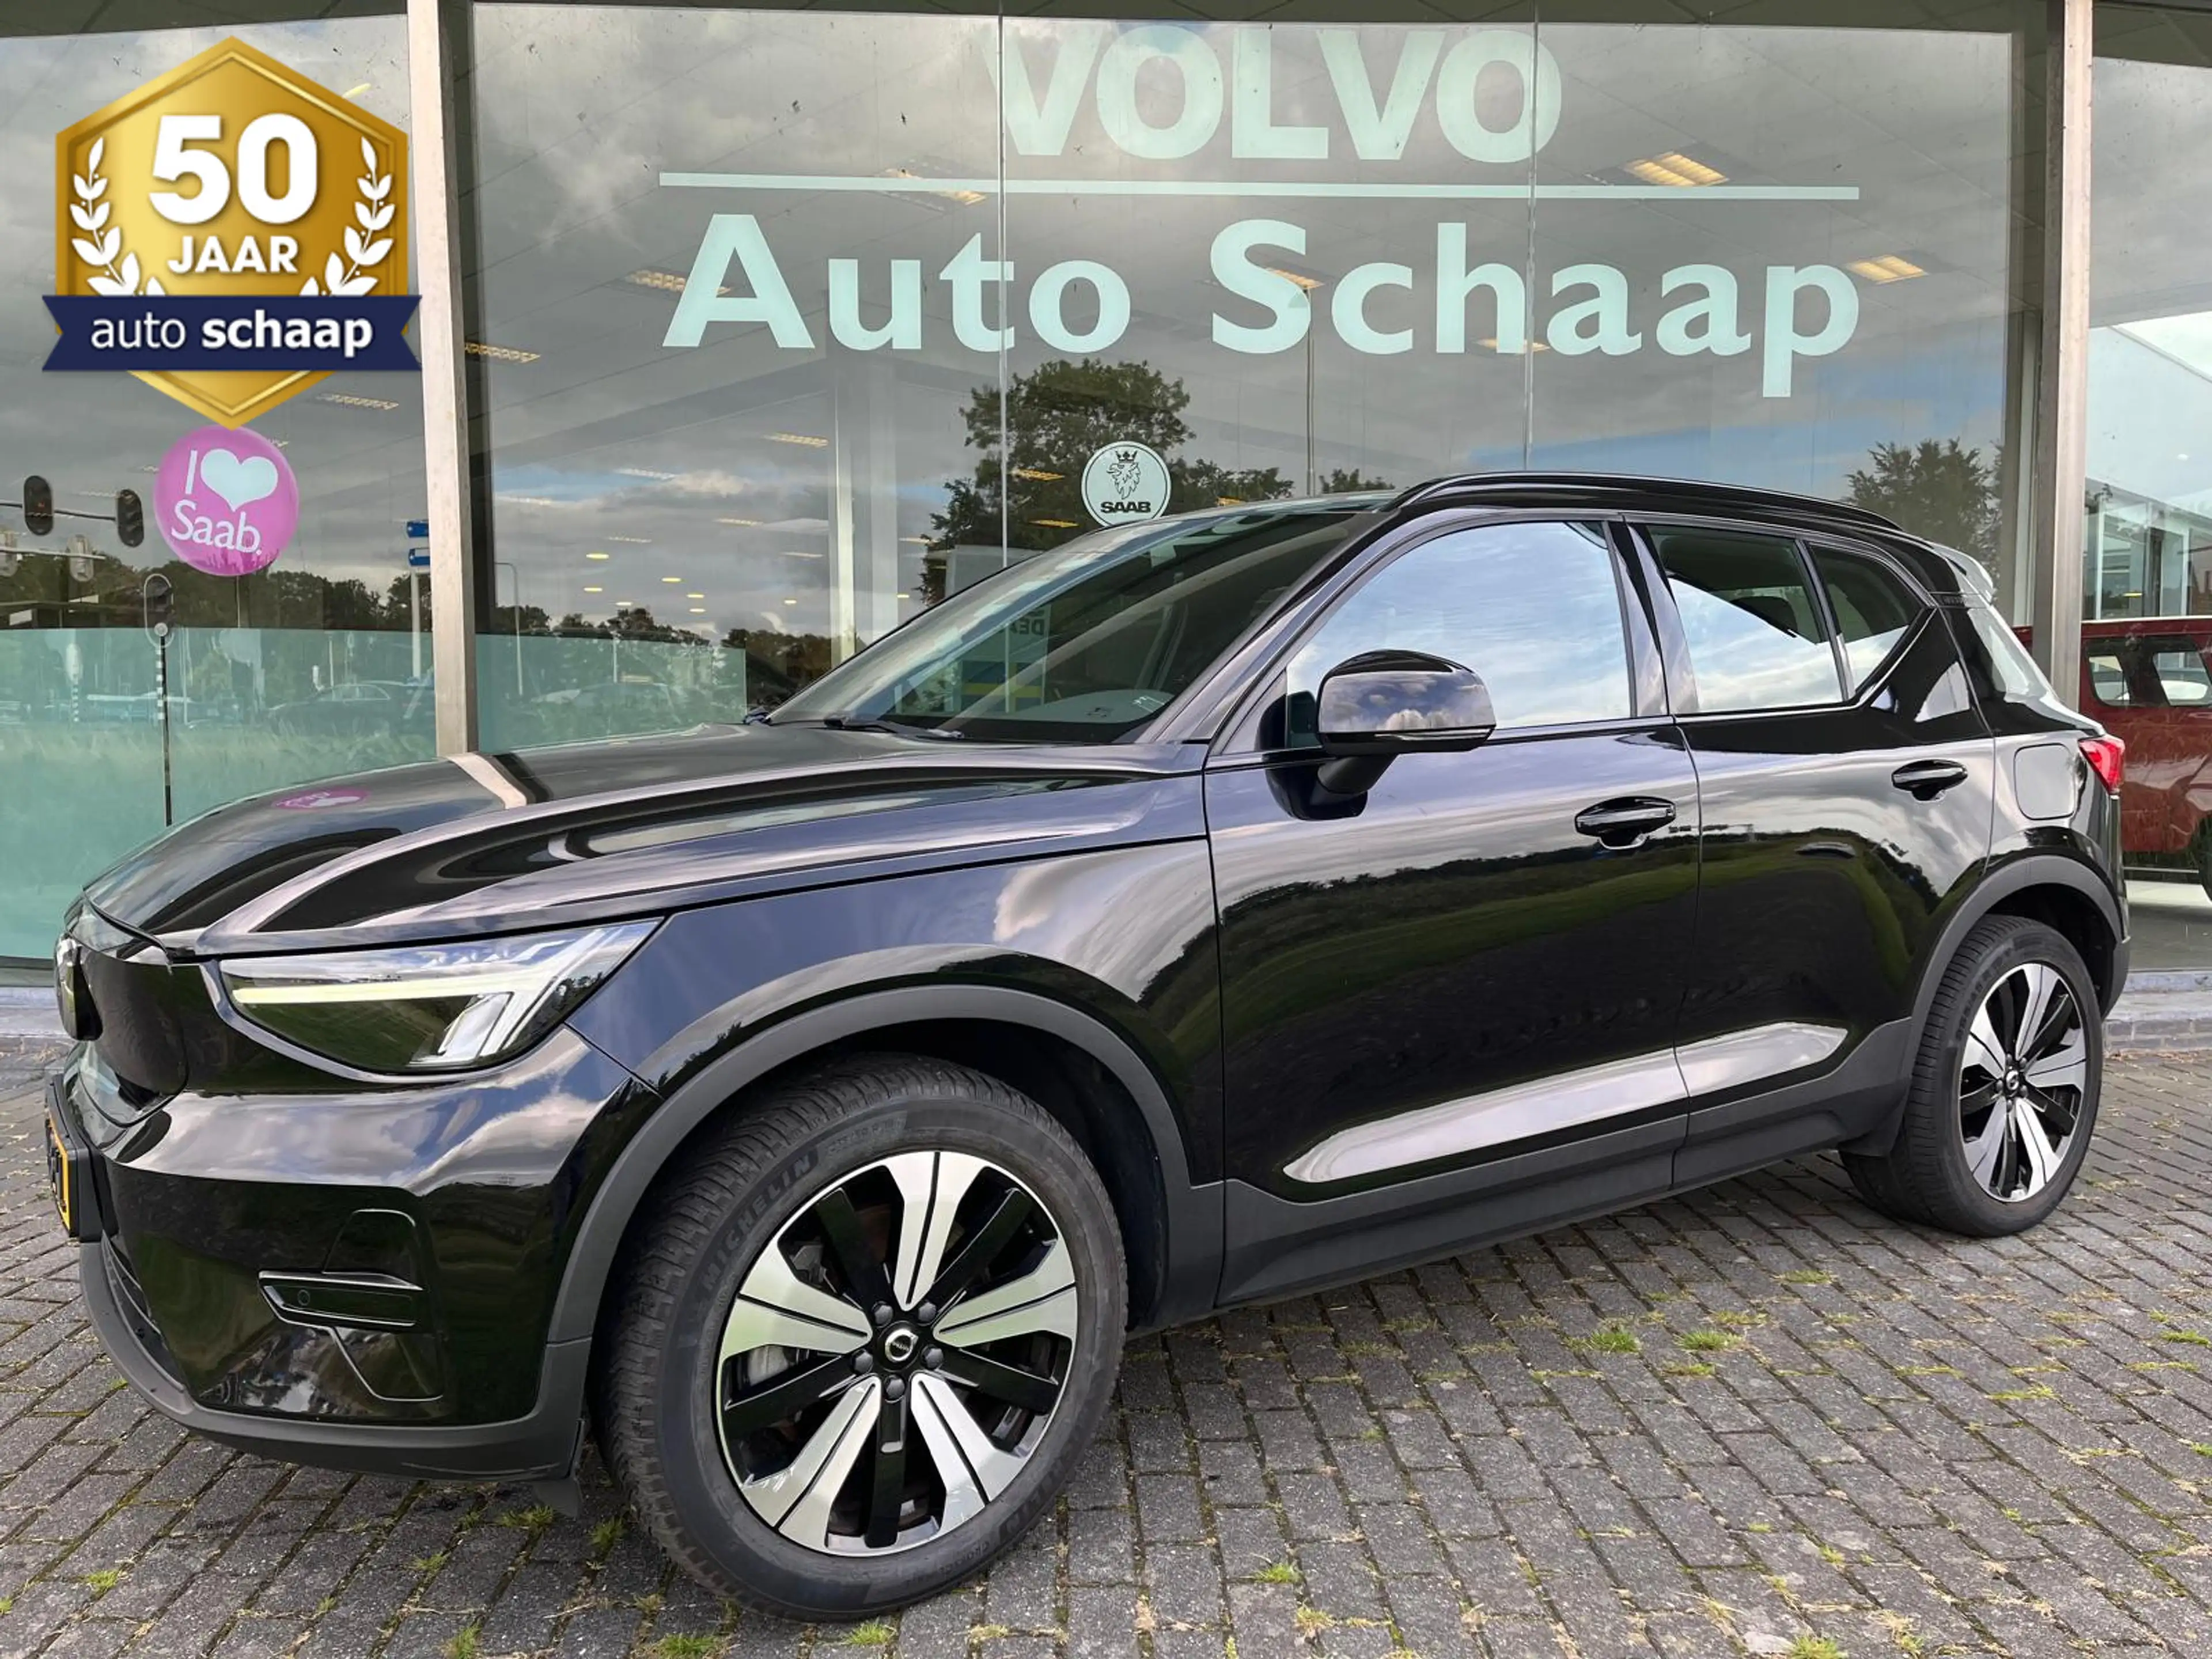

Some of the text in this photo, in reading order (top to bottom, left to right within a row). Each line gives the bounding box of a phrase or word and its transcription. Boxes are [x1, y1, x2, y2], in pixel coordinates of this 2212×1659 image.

[975, 25, 1562, 163] VOLVO
[662, 214, 1859, 398] Auto Schaap
[185, 449, 198, 494] I
[1101, 501, 1151, 513] SAAB
[702, 1153, 810, 1290] MICHELIN
